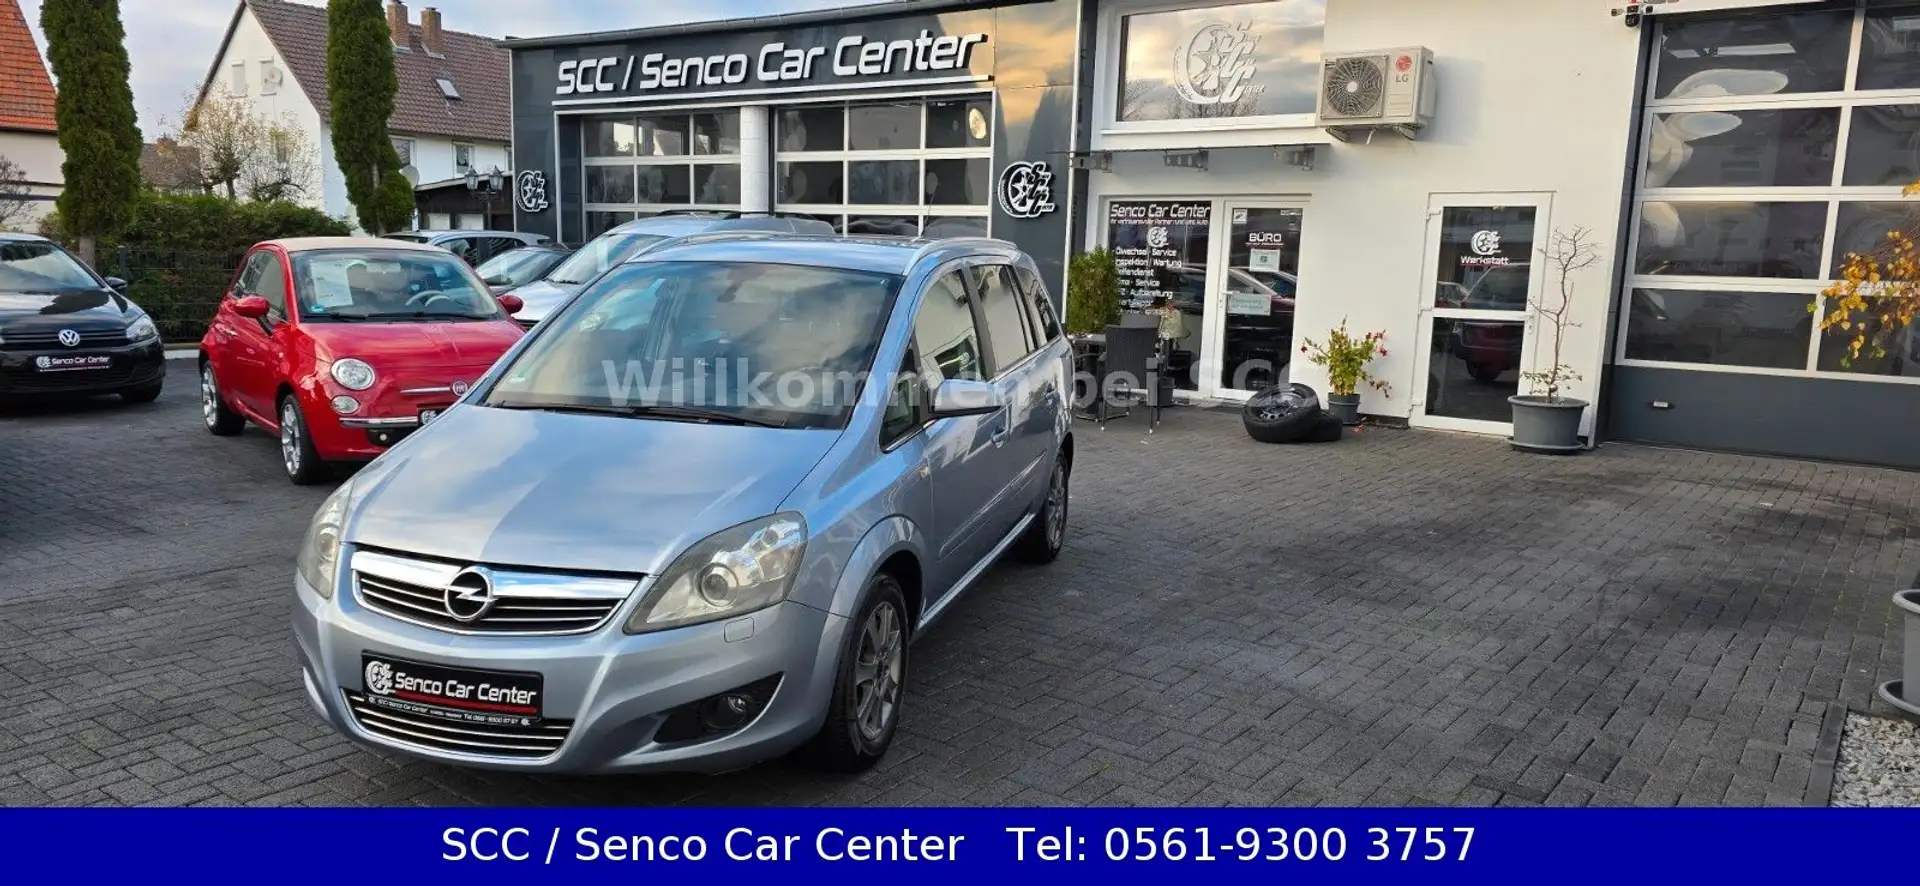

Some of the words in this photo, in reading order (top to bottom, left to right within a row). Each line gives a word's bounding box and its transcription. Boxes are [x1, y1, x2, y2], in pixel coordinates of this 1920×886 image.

[556, 57, 617, 94] SCC
[622, 55, 634, 90] /
[640, 53, 748, 89] Senco
[757, 42, 825, 81] Car
[833, 29, 985, 75] Center
[1395, 74, 1409, 83] LG
[1110, 203, 1146, 218] Senco
[1148, 203, 1168, 218] Car
[1170, 203, 1211, 218] Center
[1248, 231, 1282, 243] BÜRO
[1151, 248, 1177, 257] Service
[1460, 255, 1510, 265] Werkstatt
[75, 356, 87, 364] Car
[395, 671, 442, 695] Senco
[445, 680, 475, 699] Car
[477, 683, 537, 705] Center
